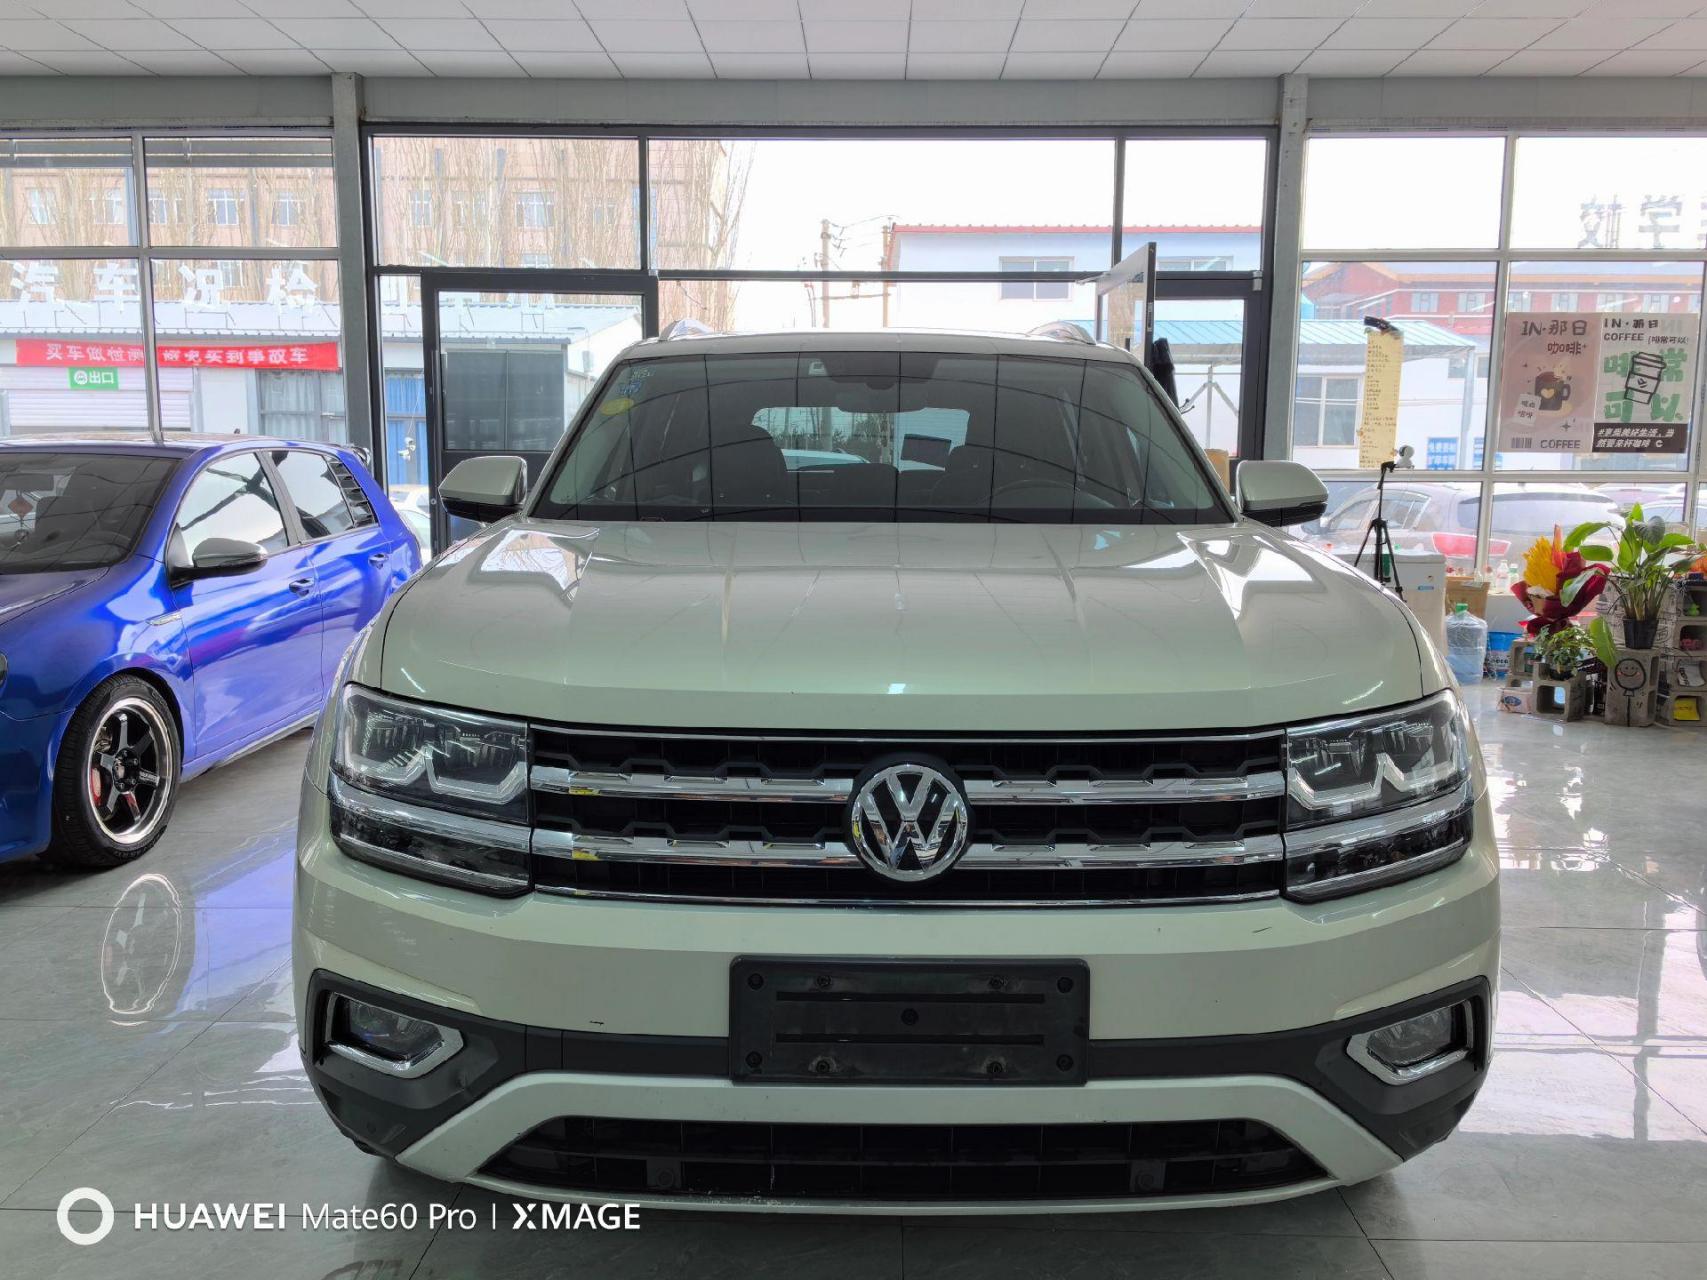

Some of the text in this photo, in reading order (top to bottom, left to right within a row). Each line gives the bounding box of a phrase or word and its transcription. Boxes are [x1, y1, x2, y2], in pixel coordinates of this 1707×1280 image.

[1603, 332, 1644, 342] COFFEE
[1547, 341, 1583, 355] 咖啡
[89, 370, 114, 384] 出口
[1540, 439, 1581, 449] COFFEE
